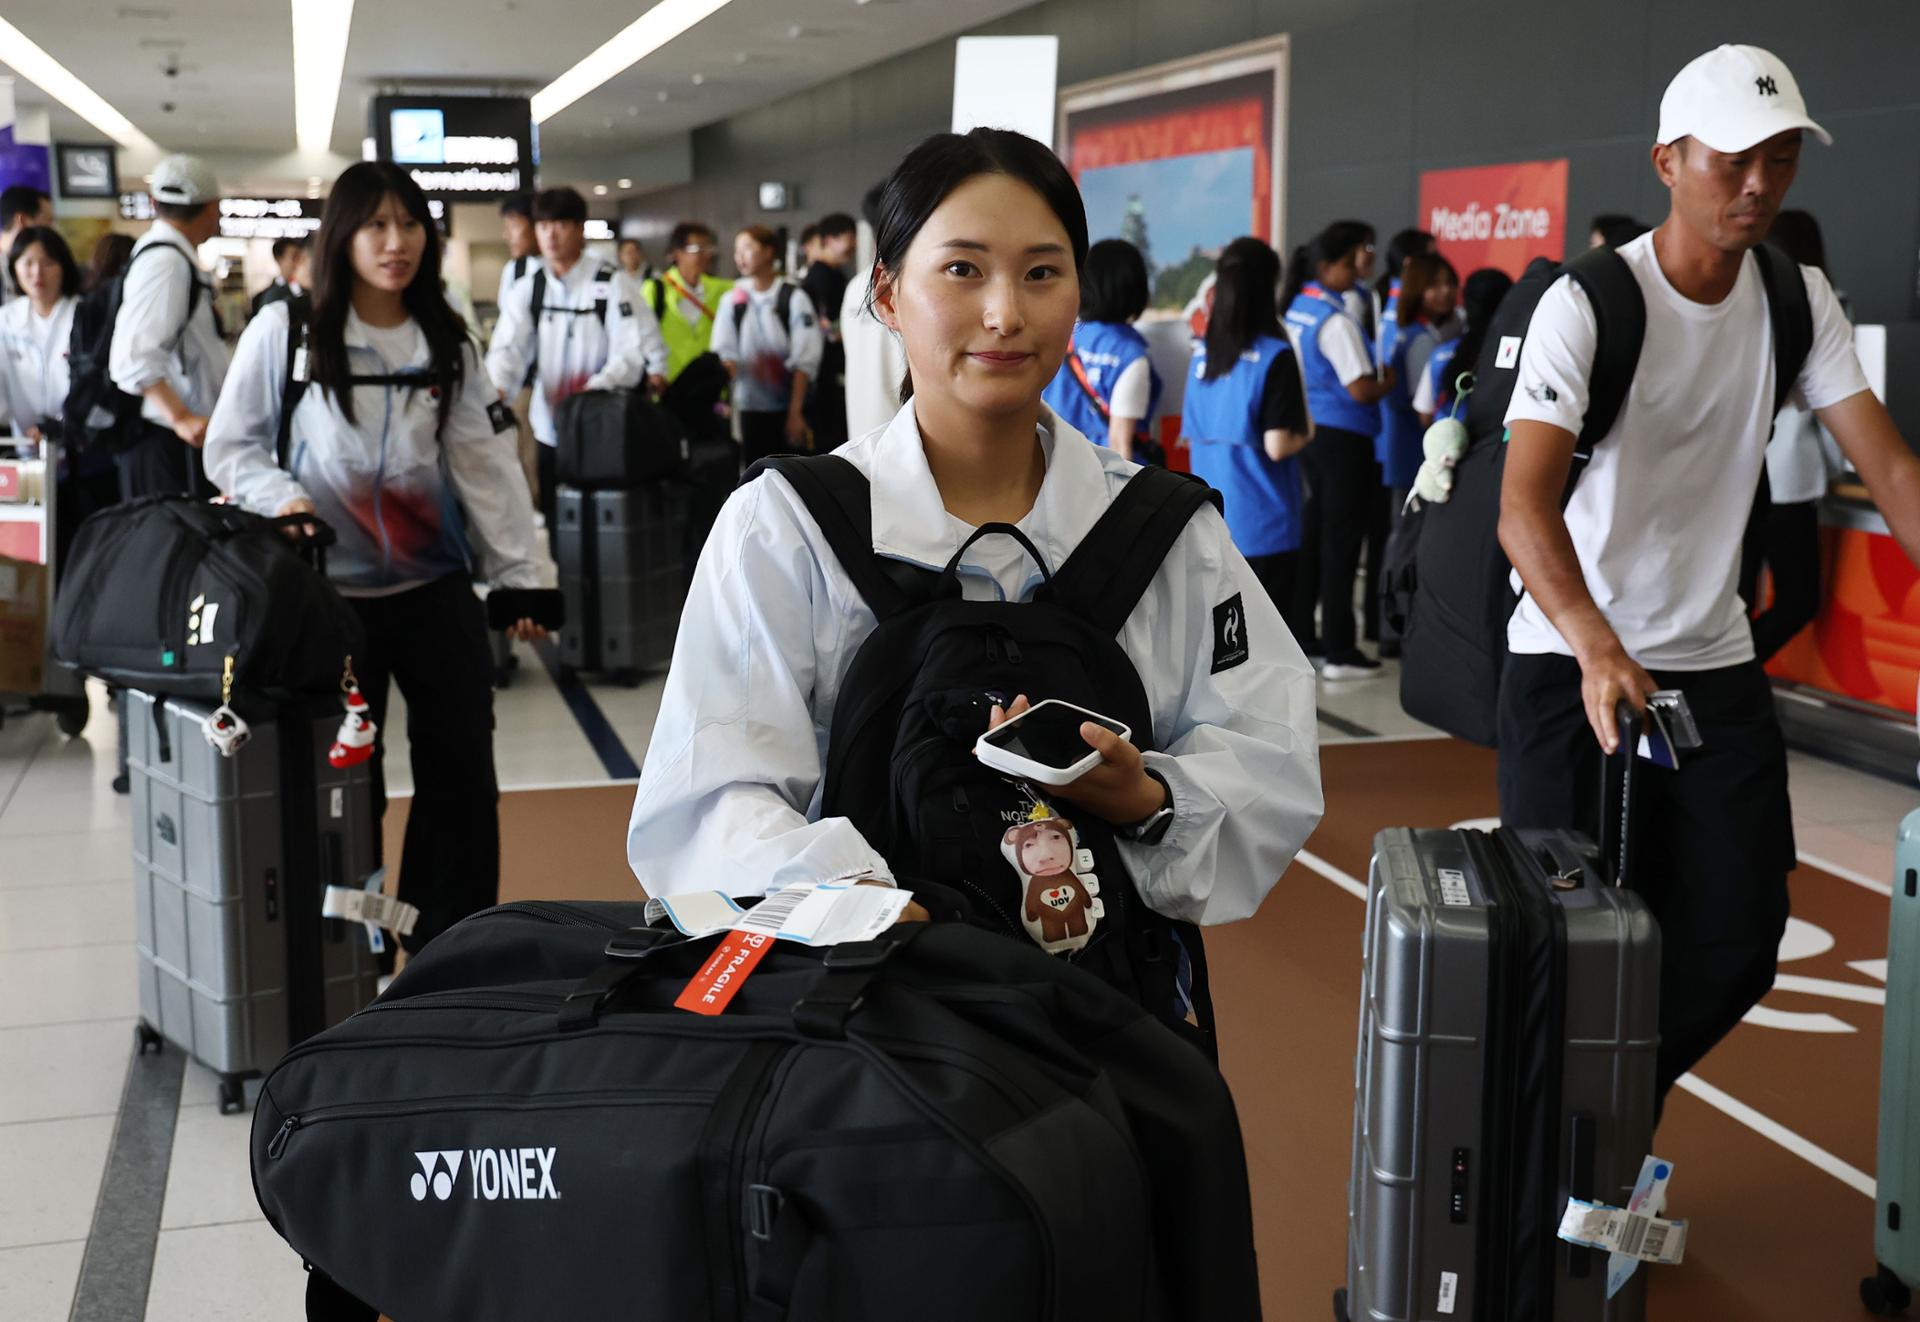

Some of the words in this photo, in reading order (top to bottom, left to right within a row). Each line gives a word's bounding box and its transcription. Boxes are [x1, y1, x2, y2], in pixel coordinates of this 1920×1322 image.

[1430, 201, 1492, 241] Media
[1494, 202, 1549, 239] Zone
[702, 948, 751, 1004] FRAGILE
[468, 1147, 557, 1201] YONEX
